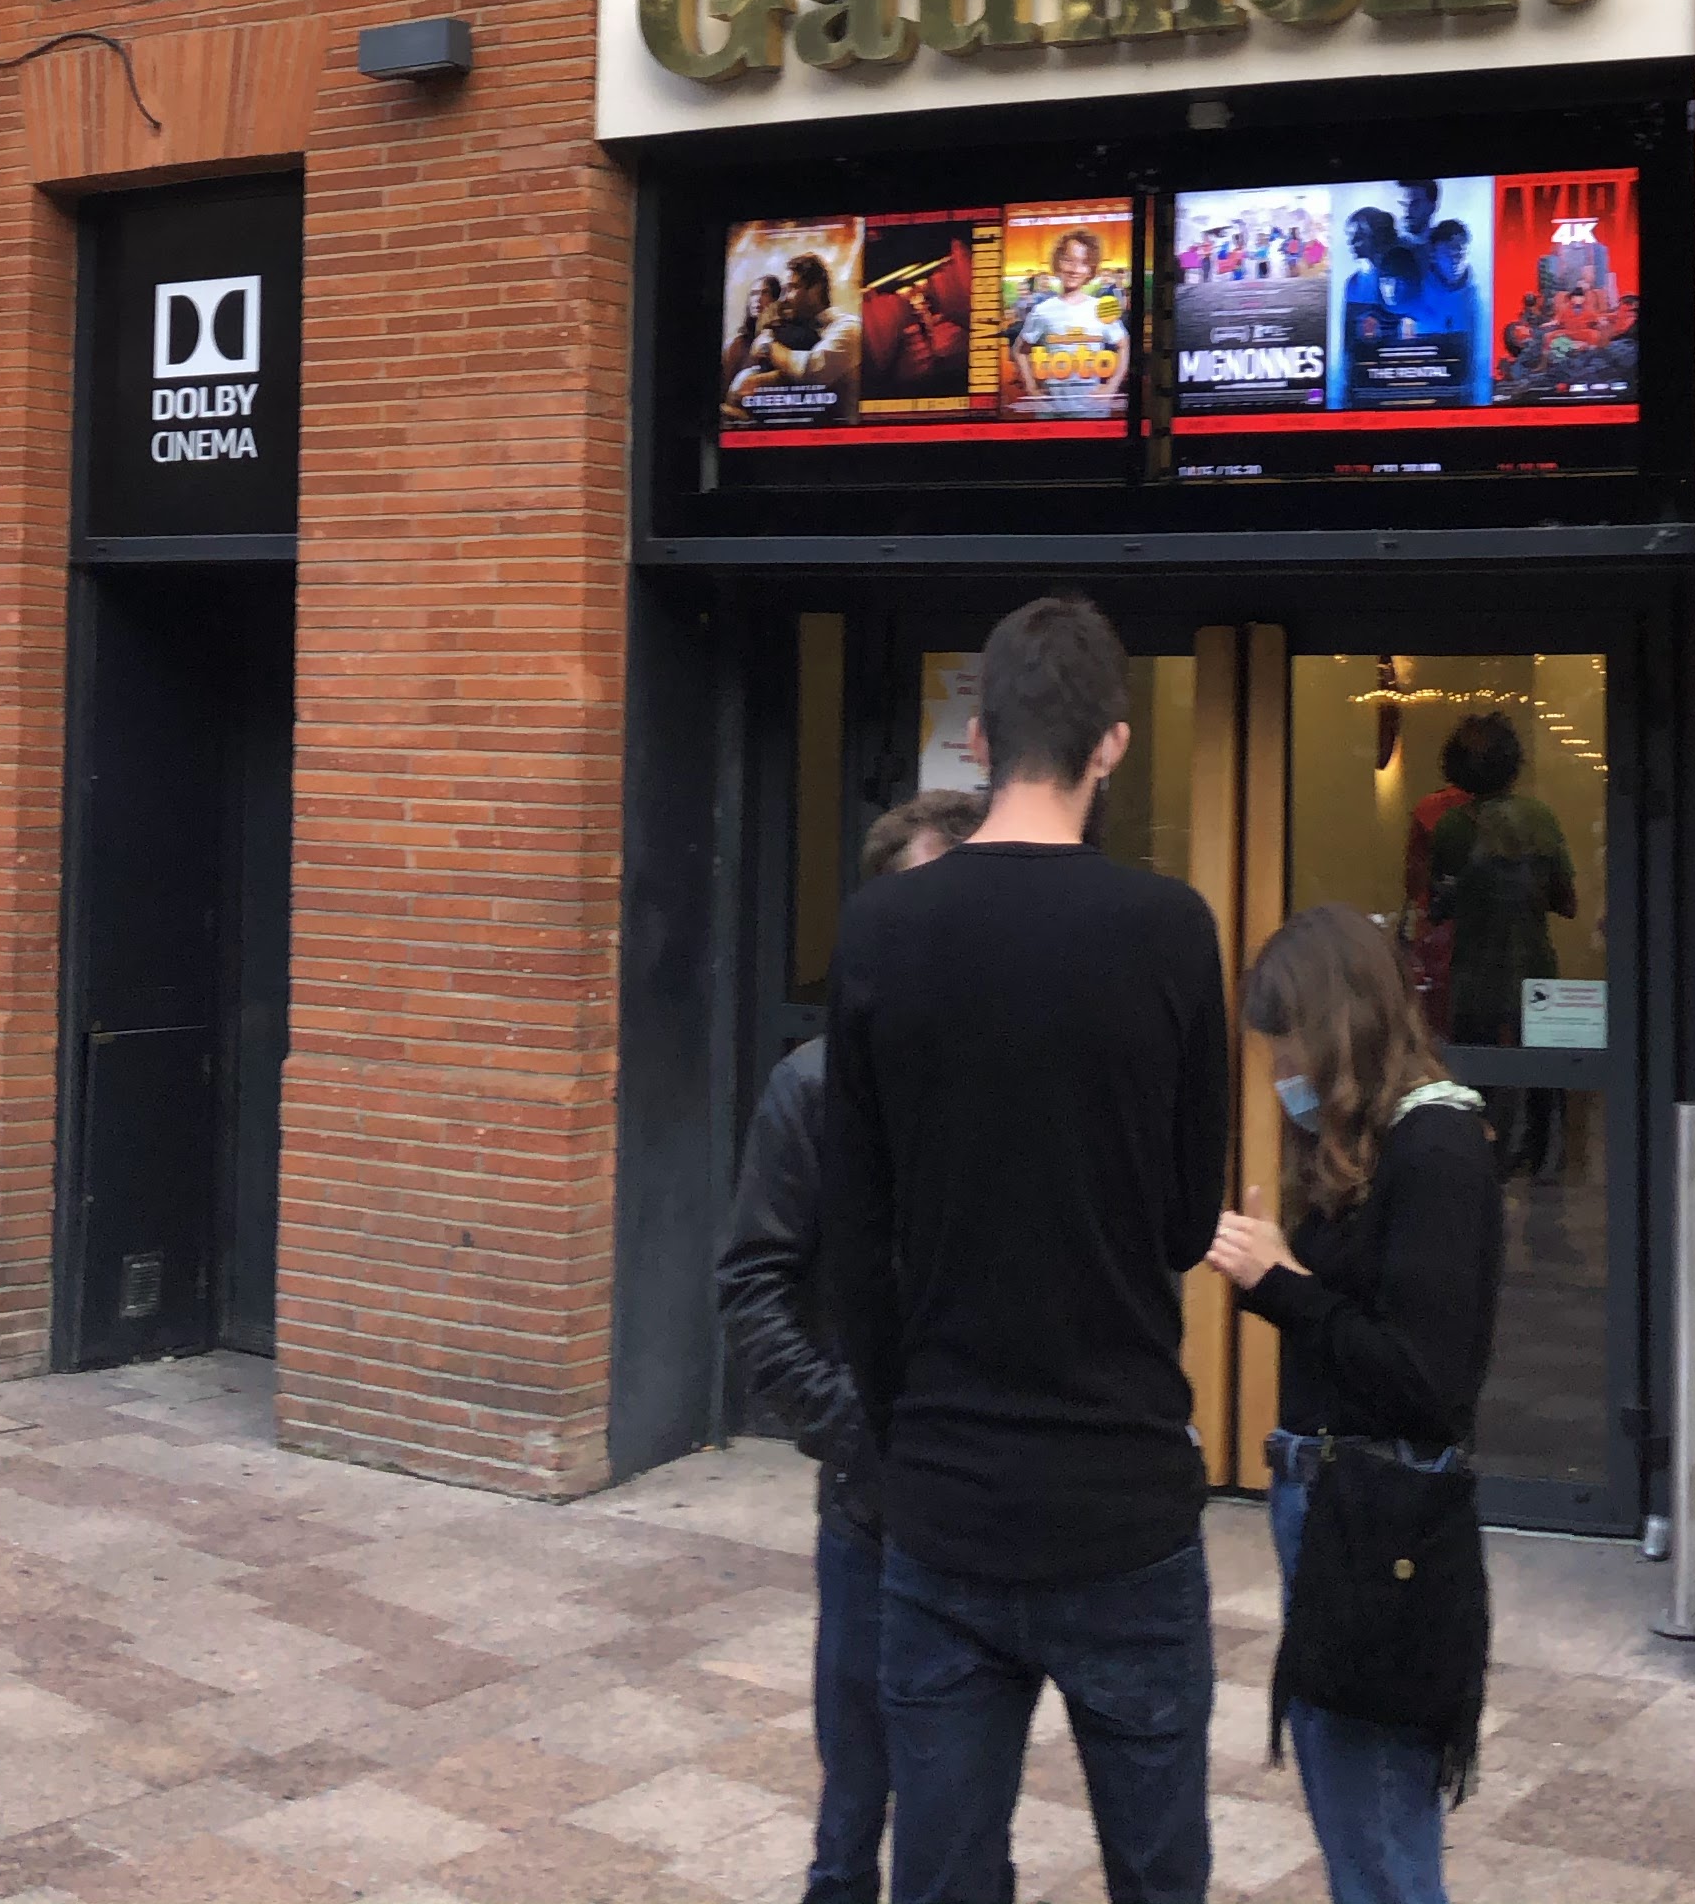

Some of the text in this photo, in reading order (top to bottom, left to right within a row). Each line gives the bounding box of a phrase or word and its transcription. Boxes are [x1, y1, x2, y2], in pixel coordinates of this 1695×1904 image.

[1550, 221, 1600, 246] 4K
[1028, 344, 1119, 381] toto
[1177, 345, 1325, 384] MIGNONNES
[151, 383, 260, 422] DOLBY
[150, 427, 259, 464] CINEMA
